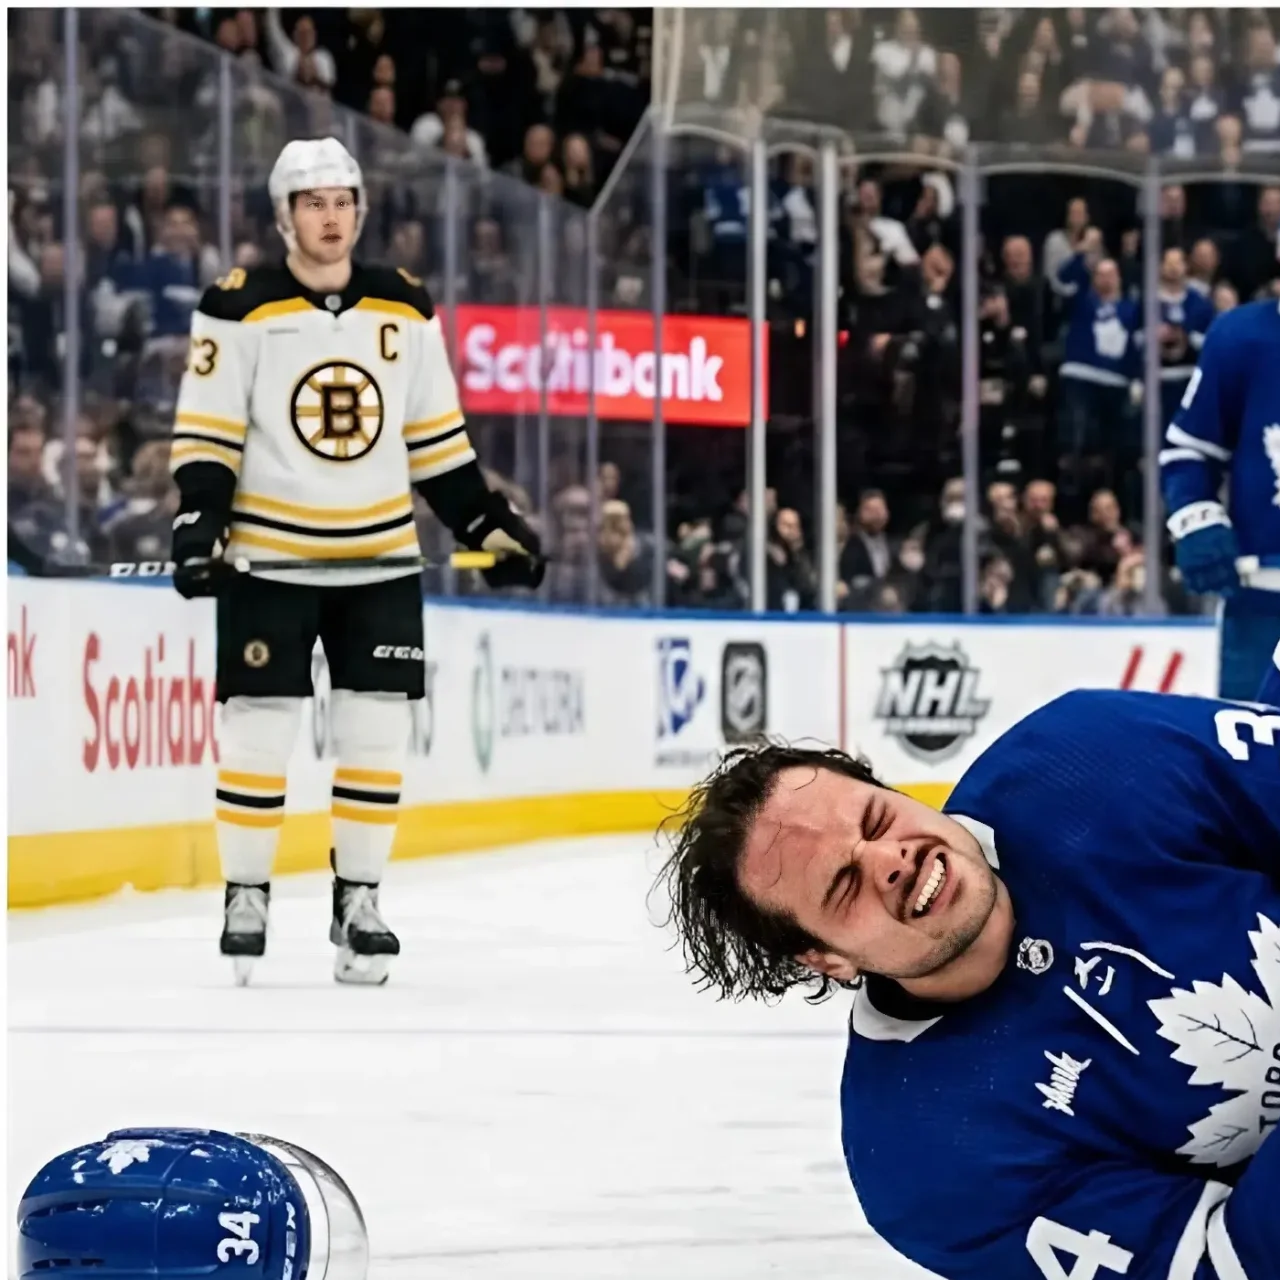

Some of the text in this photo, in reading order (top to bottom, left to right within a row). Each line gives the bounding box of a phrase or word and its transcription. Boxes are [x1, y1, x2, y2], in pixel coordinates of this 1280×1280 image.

[379, 323, 399, 362] C
[876, 668, 992, 718] NHL
[217, 1210, 261, 1265] 34
